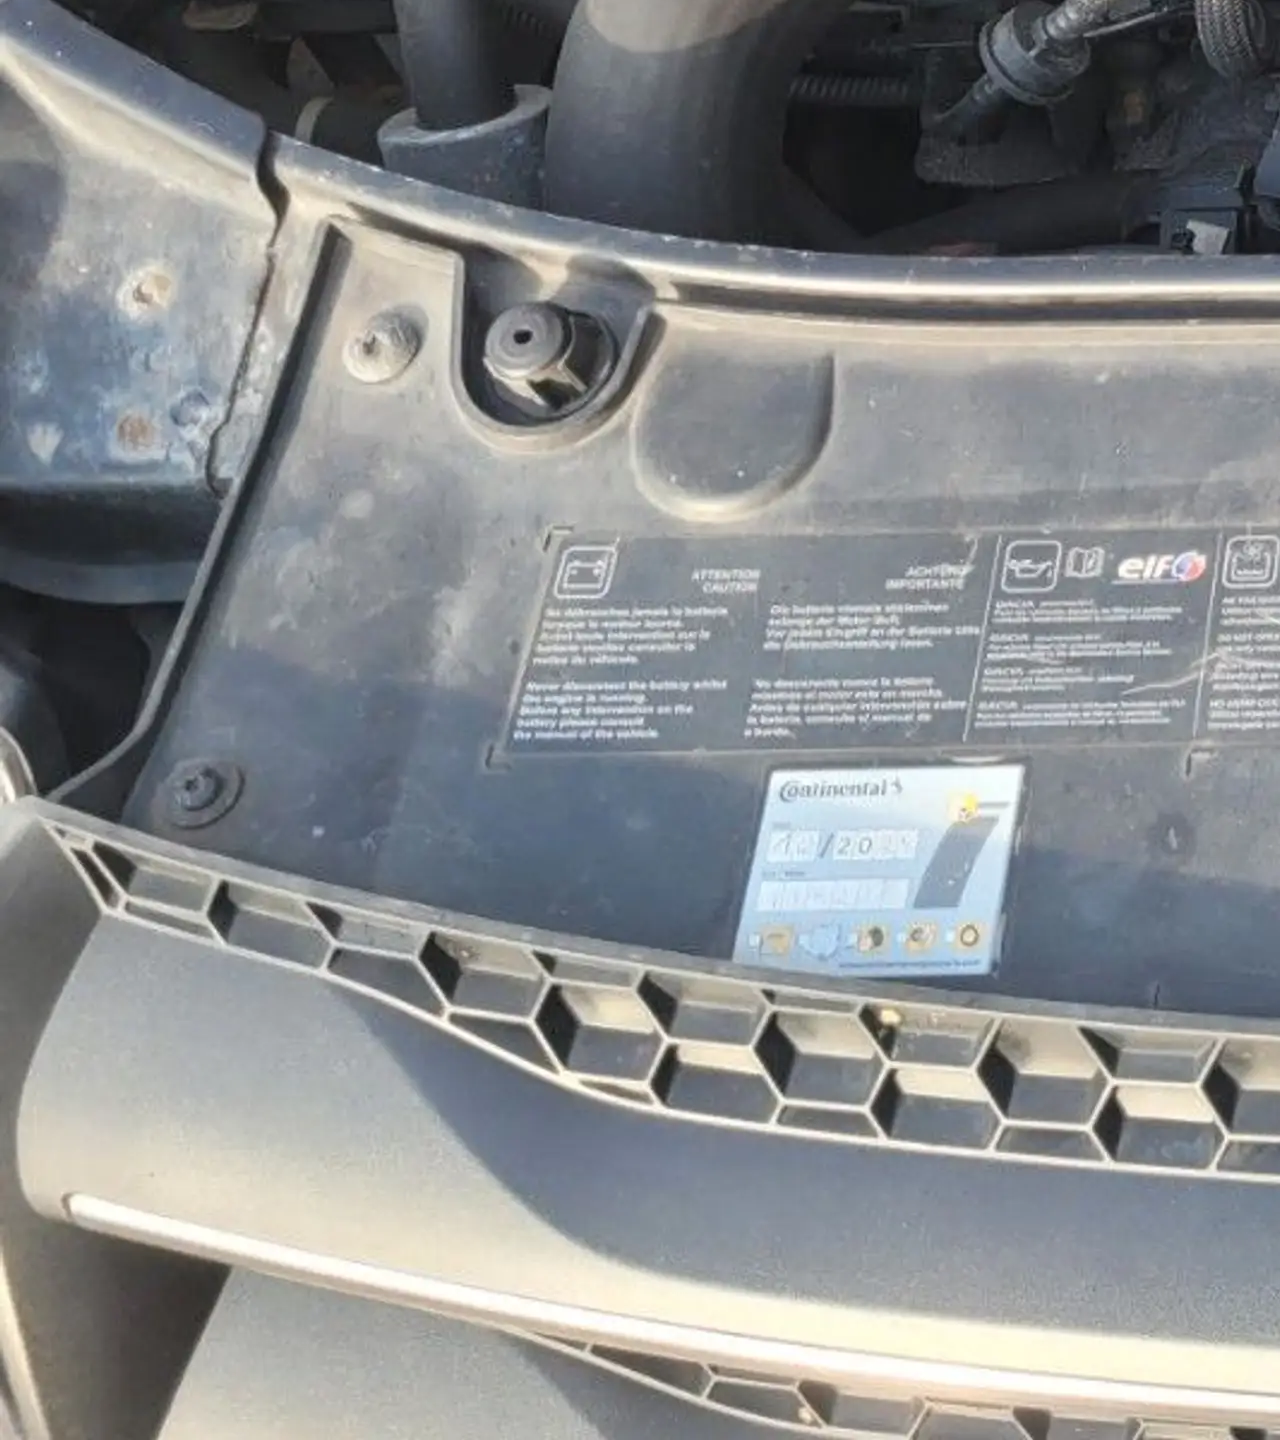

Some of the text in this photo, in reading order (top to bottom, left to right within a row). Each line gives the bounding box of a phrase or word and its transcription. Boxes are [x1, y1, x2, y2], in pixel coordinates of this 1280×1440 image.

[691, 569, 761, 580] ATTENTION
[703, 582, 757, 593] CAUTION
[779, 780, 887, 802] Continental
